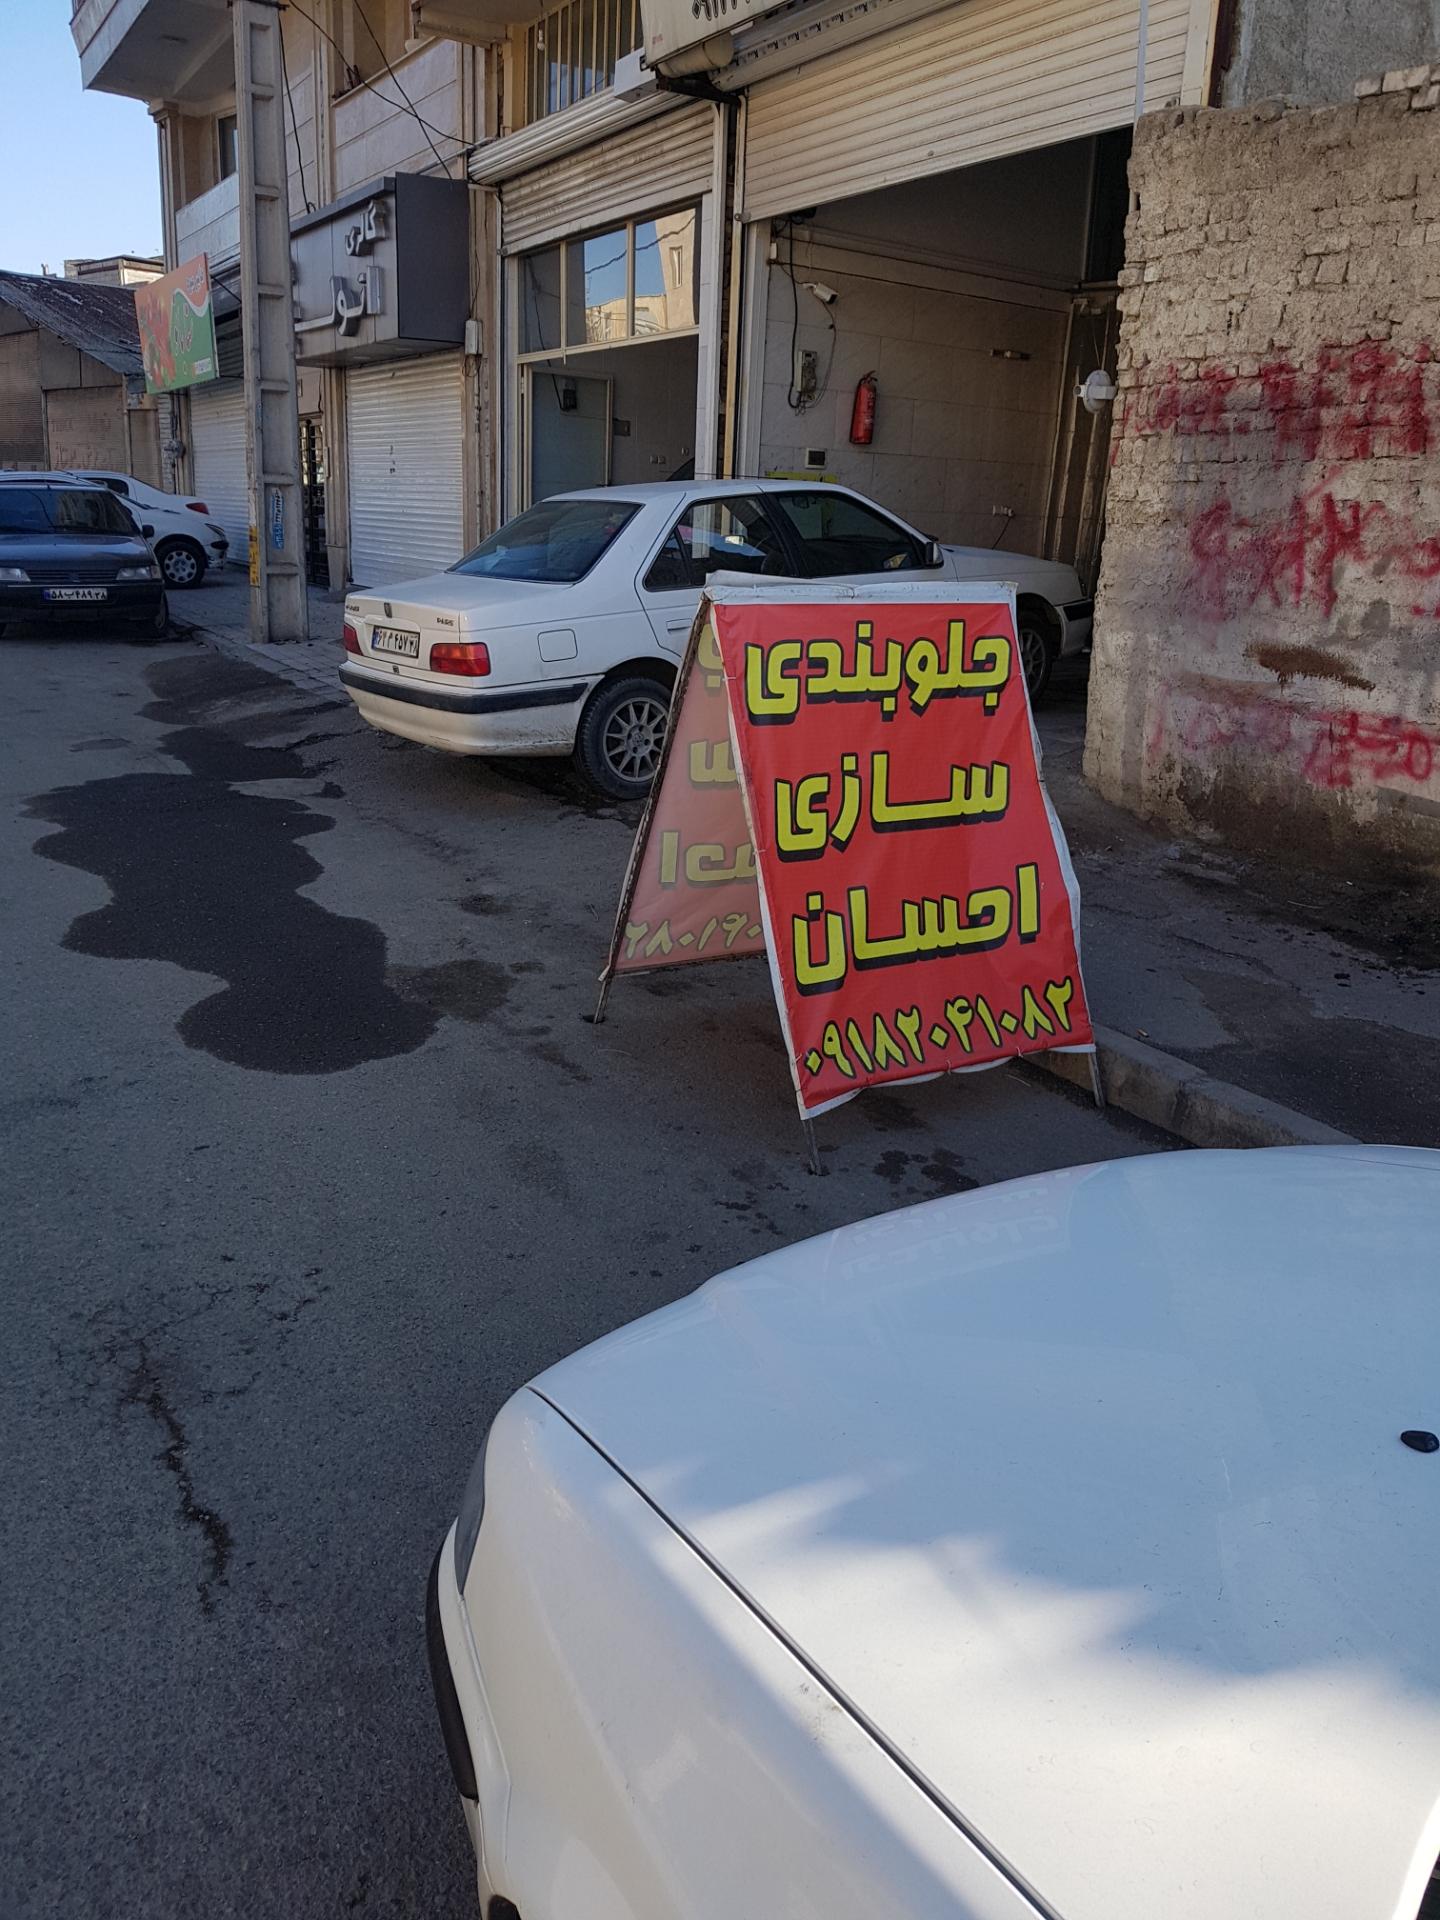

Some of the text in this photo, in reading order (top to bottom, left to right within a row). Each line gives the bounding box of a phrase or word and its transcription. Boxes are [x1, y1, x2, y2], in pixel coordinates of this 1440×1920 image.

[345, 200, 385, 256] گالری
[745, 619, 1012, 723] جلوبندی
[775, 751, 1010, 861] سازی
[793, 863, 1039, 995] احسان
[804, 976, 1073, 1078] ۰۹۱۸۲۰۴۱۰۸۲
